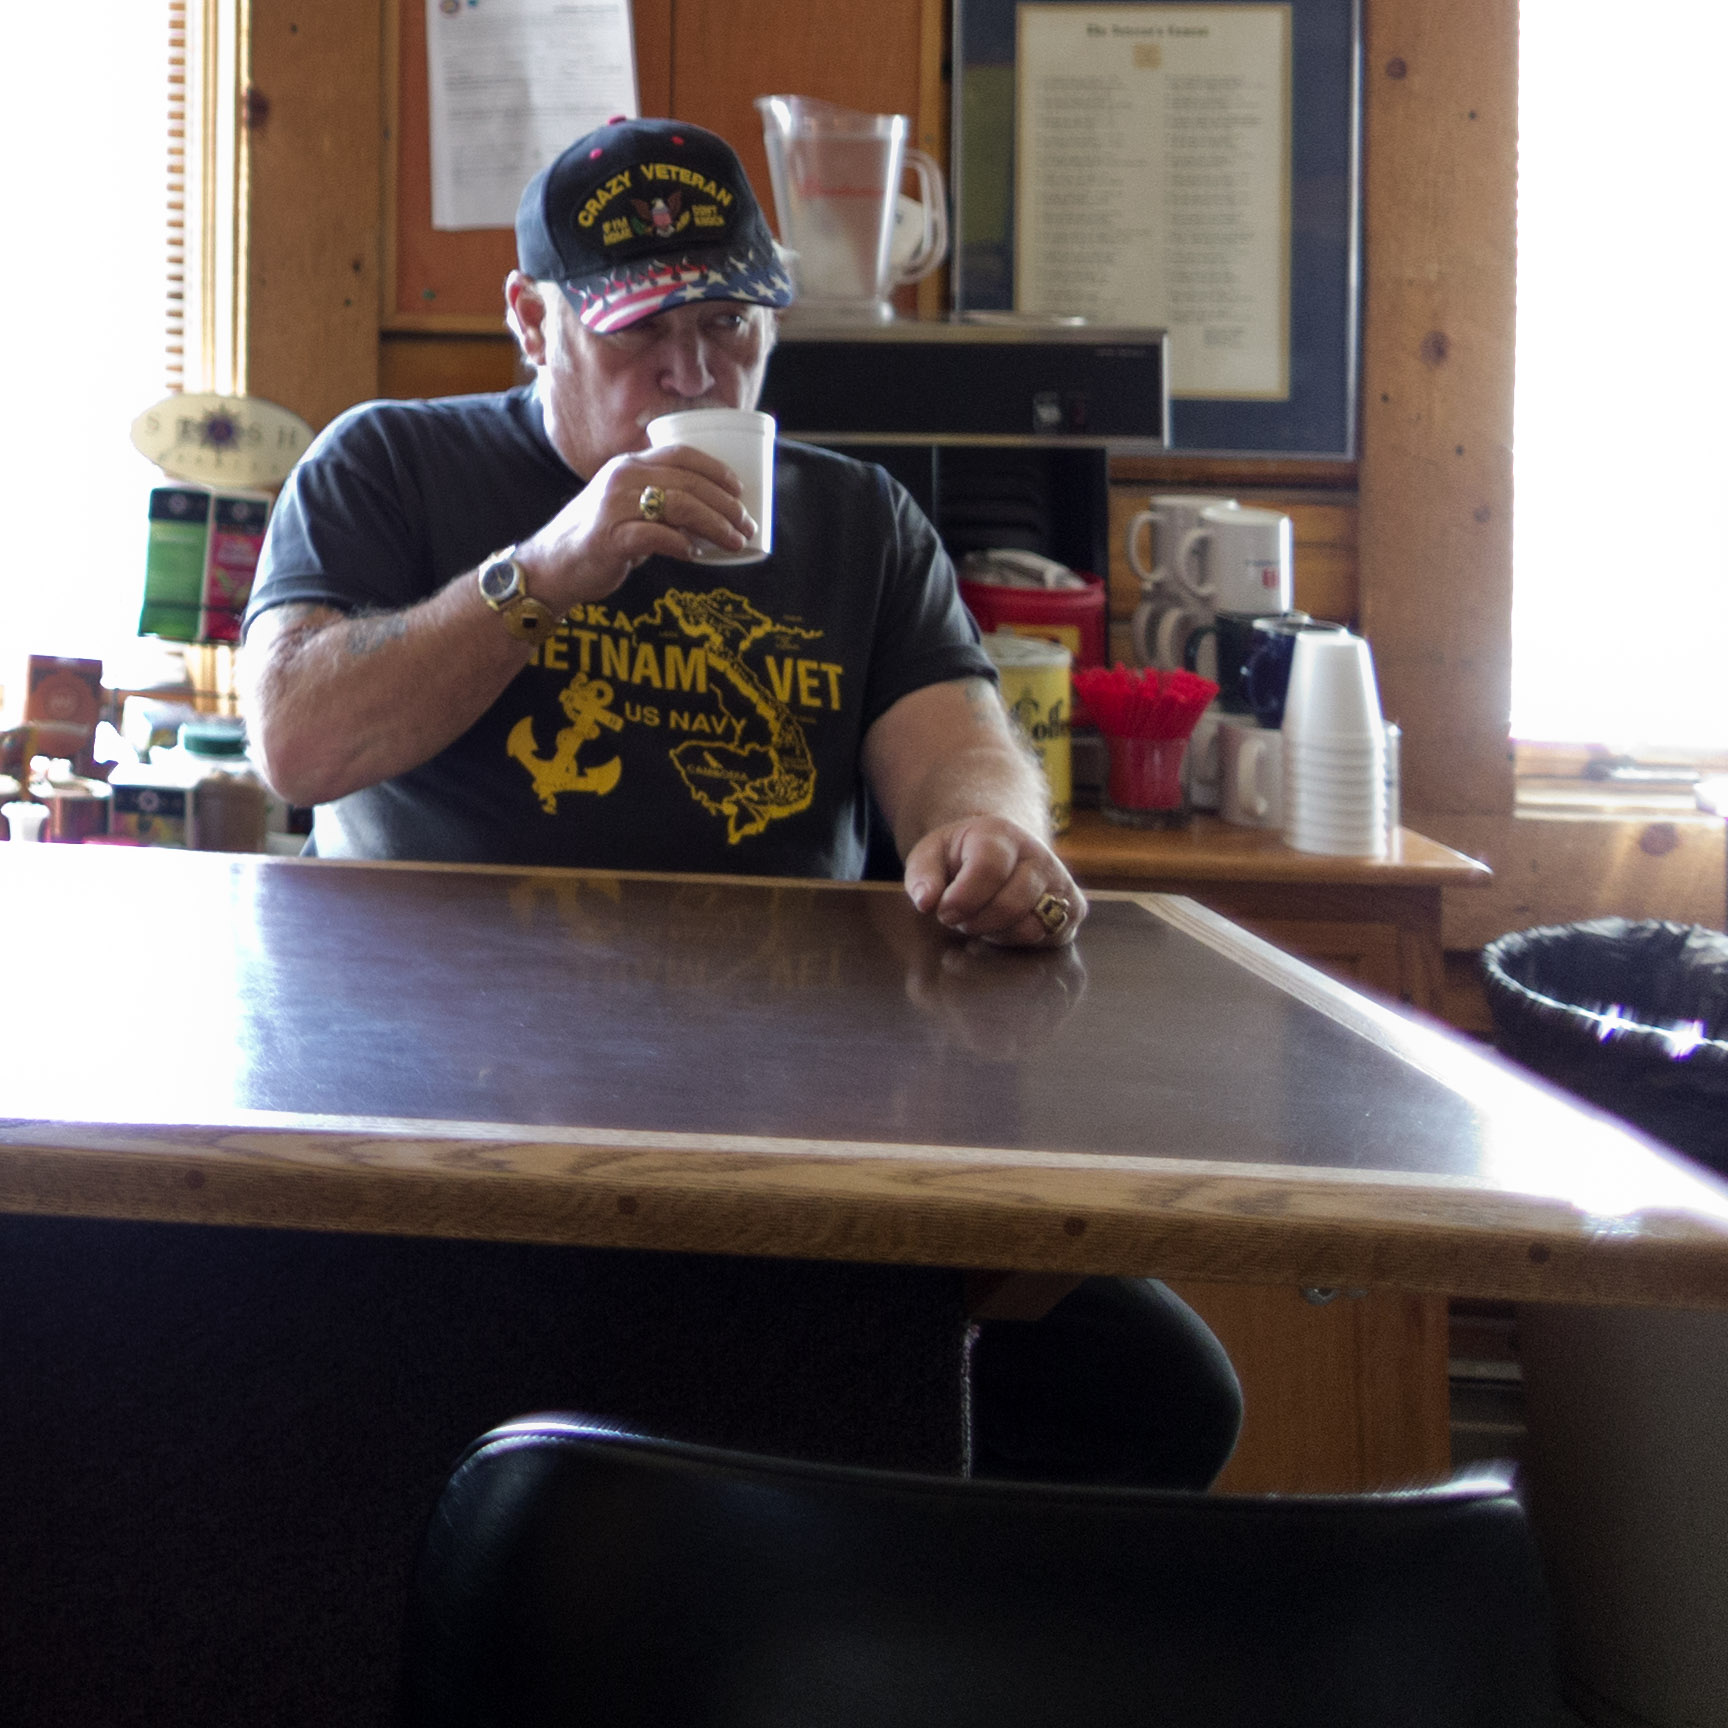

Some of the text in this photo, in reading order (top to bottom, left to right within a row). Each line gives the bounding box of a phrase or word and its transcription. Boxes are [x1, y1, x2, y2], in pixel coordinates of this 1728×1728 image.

[578, 163, 734, 228] CRAZY VETERAN
[529, 625, 844, 712] ETNAM VET
[625, 701, 748, 736] US NAVY
